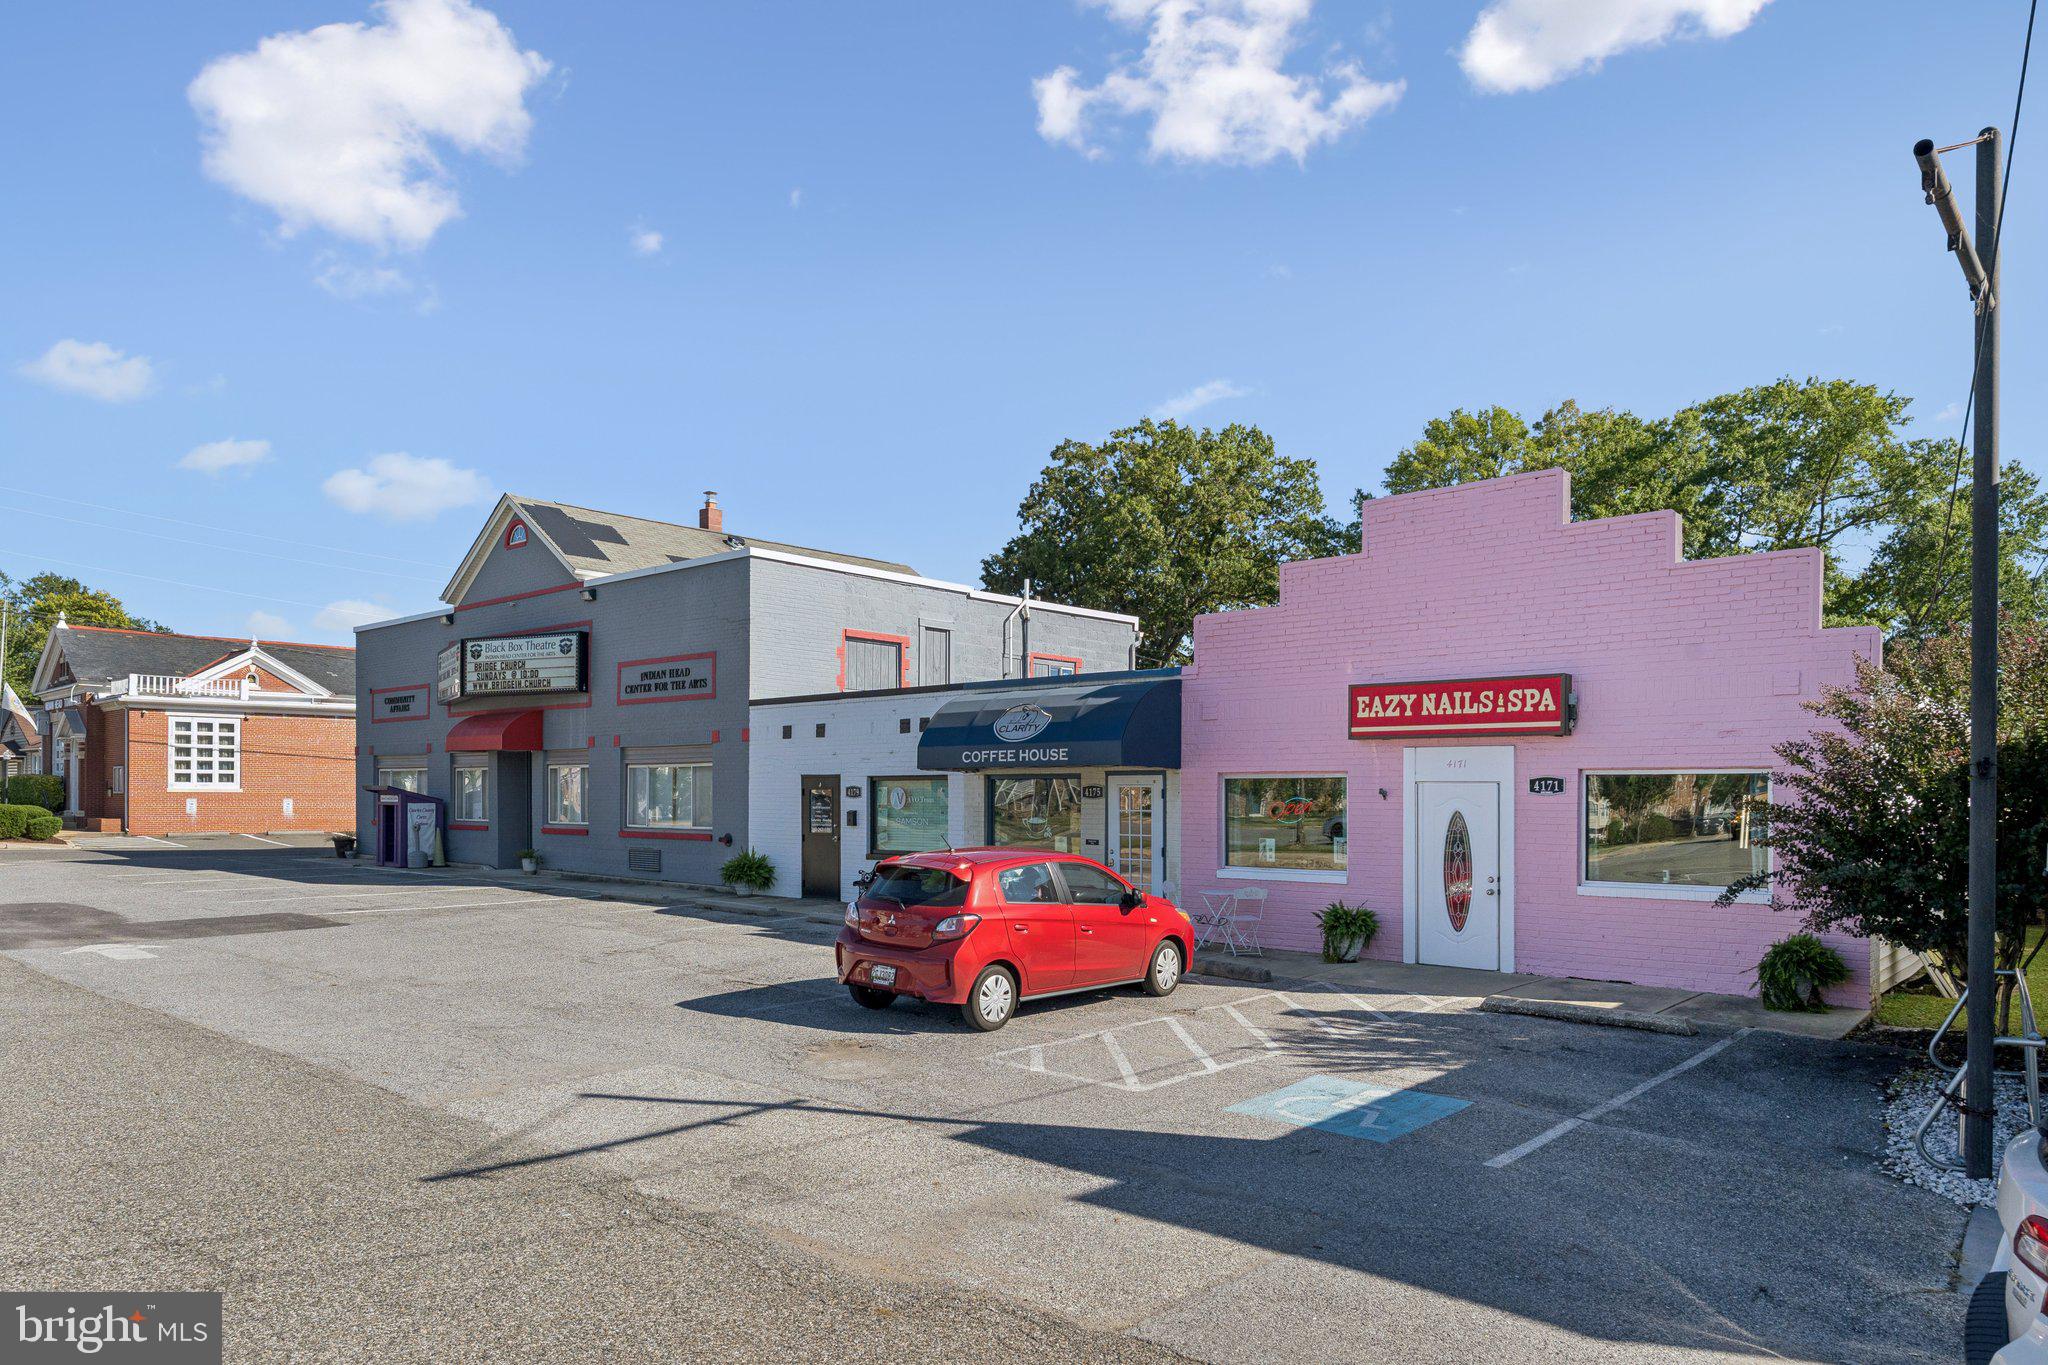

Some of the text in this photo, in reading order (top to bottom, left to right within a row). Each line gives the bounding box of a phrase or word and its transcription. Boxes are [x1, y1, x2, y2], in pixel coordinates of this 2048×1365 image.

[485, 640, 557, 654] Black Box Theatre
[474, 660, 526, 672] BRIDGE CHURCH
[476, 671, 507, 681] SUNDAYS
[640, 667, 691, 681] INDIAN HEAD
[625, 678, 708, 694] CENTER FOR THE ARTS
[1356, 693, 1417, 718] EAZY
[1421, 690, 1494, 716] NAILS
[1507, 687, 1556, 713] SPA
[999, 723, 1041, 733] CLARITY
[961, 748, 1069, 763] COFFEE HOUSE
[1446, 759, 1467, 768] 4171
[1084, 787, 1101, 797] 4175
[1533, 780, 1560, 792] 4171
[1267, 800, 1313, 820] Open
[895, 817, 929, 826] SAMSON
